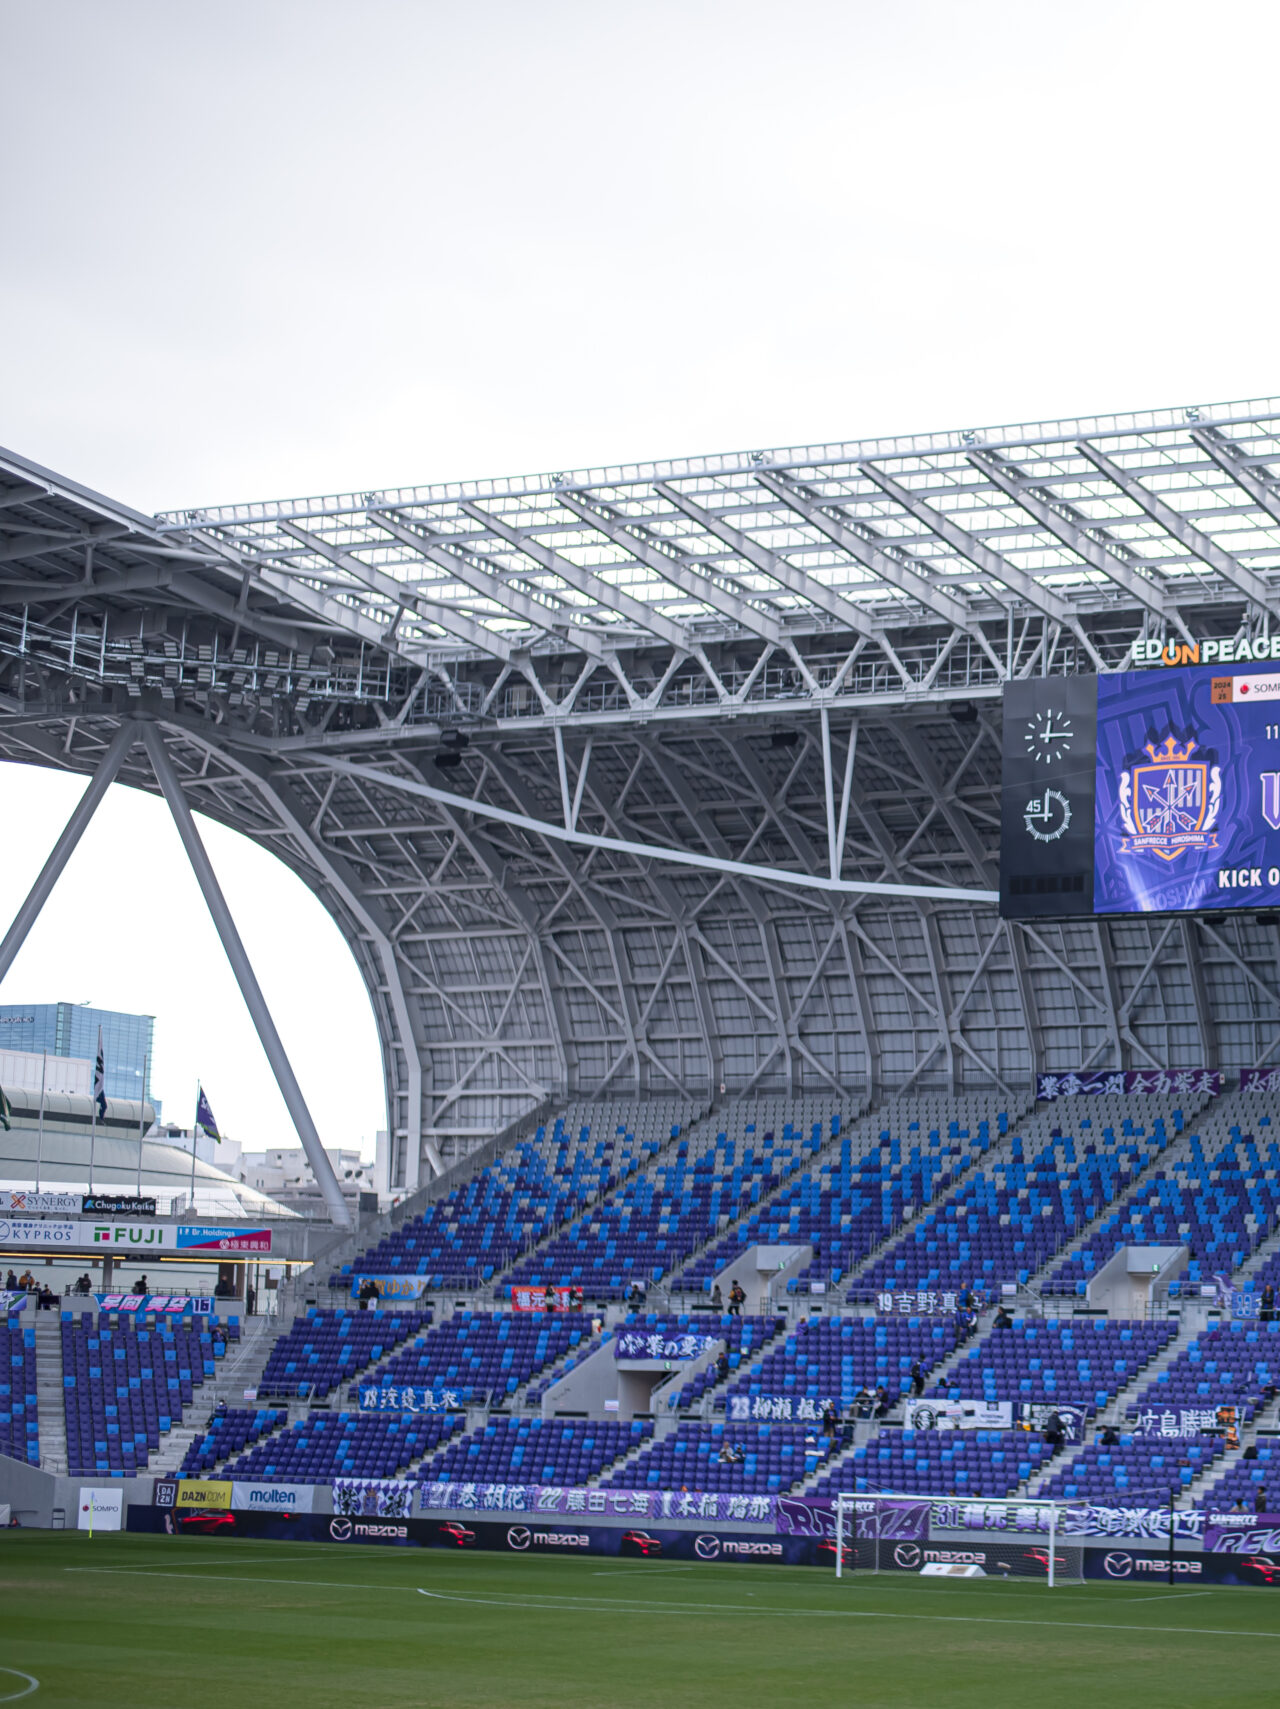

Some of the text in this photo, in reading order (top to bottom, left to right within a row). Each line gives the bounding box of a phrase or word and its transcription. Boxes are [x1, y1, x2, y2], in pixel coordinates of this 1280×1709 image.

[1026, 800, 1041, 812] 45
[1218, 869, 1262, 888] KICK
[27, 1197, 79, 1207] SYNERGY
[95, 1201, 131, 1211] Chugoku
[14, 1230, 72, 1240] KYPROS
[115, 1228, 164, 1244] FUJI
[193, 1298, 211, 1314] 16
[877, 1293, 892, 1312] 19
[250, 1490, 296, 1504] molten
[429, 1484, 452, 1506] 21
[536, 1487, 563, 1512] 22
[92, 1504, 119, 1513] SOMPO
[936, 1504, 959, 1528] 31
